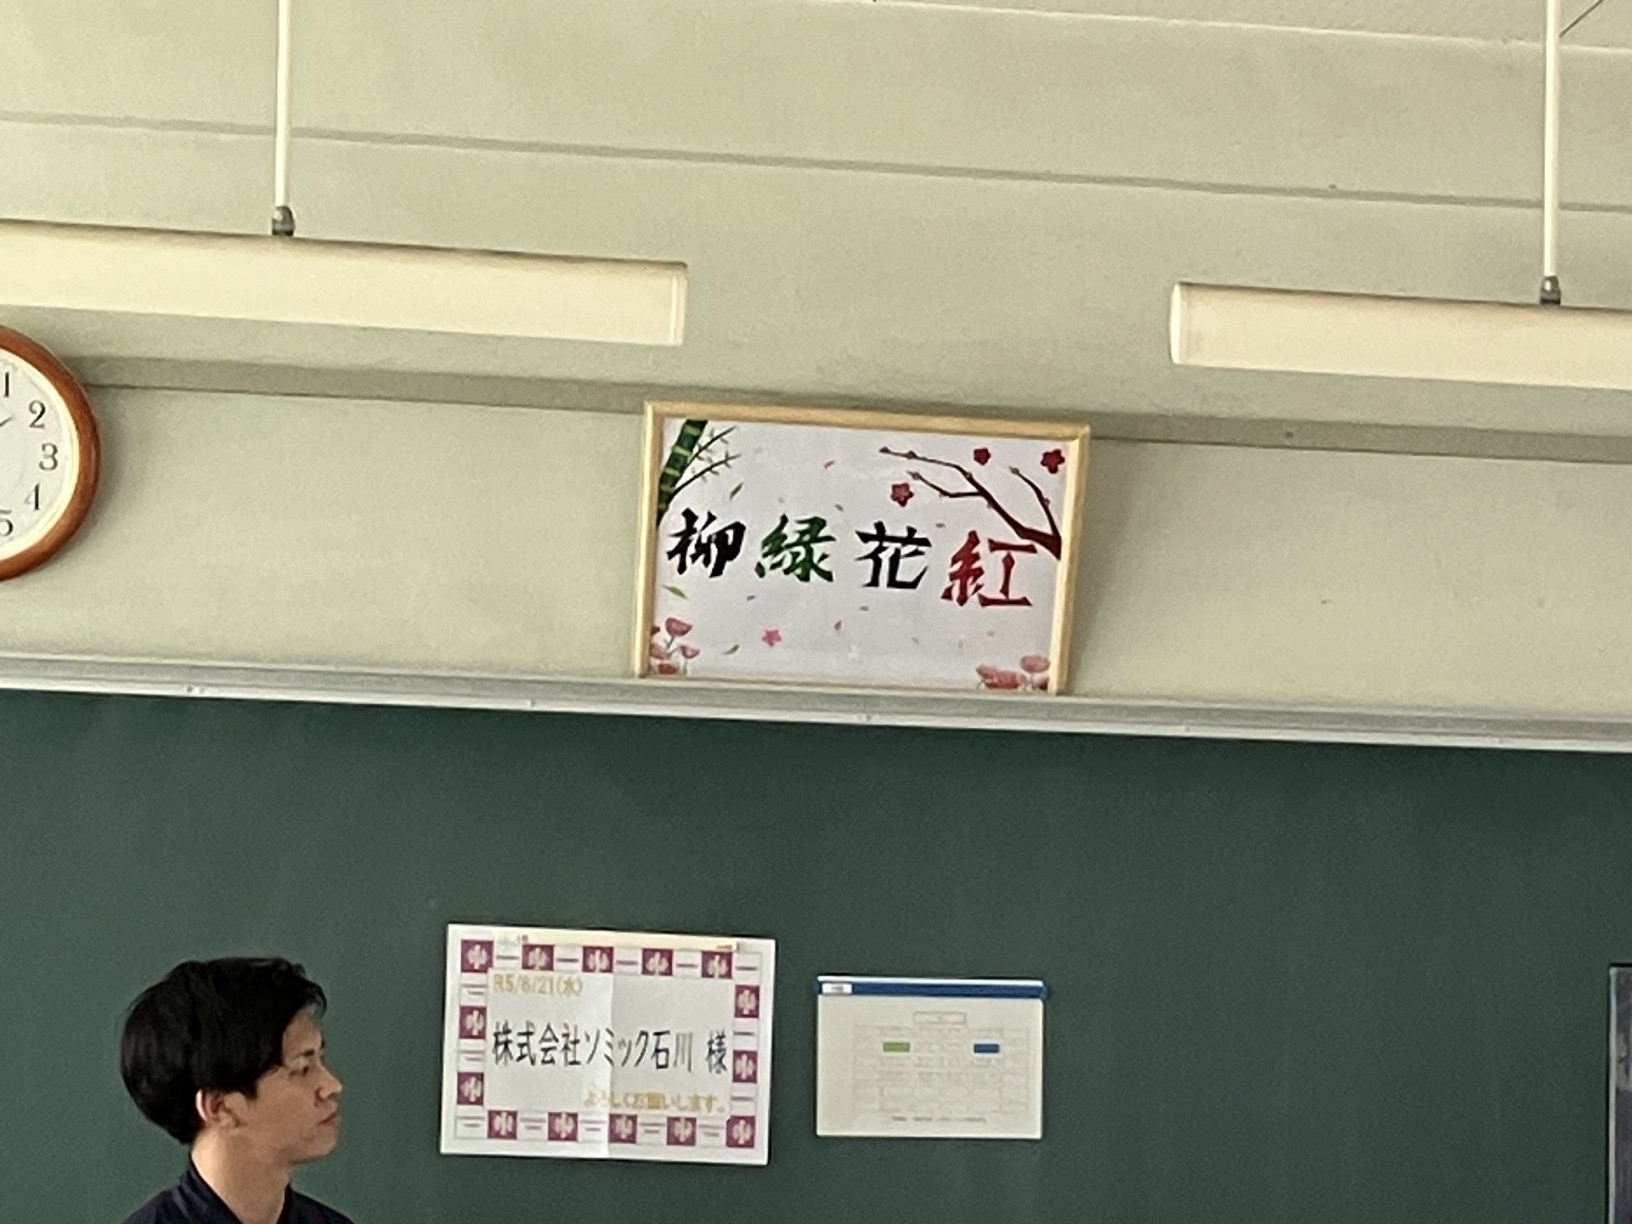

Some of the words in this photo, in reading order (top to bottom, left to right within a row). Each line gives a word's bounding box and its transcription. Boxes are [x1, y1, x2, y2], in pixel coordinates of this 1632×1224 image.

[3, 371, 11, 398] 1
[28, 400, 46, 429] 2
[38, 443, 59, 471] 3
[24, 483, 41, 511] 4
[667, 508, 1038, 608] 柳緑花紅
[492, 1020, 694, 1073] 株式会社ソミック石川
[705, 1028, 729, 1075] 様
